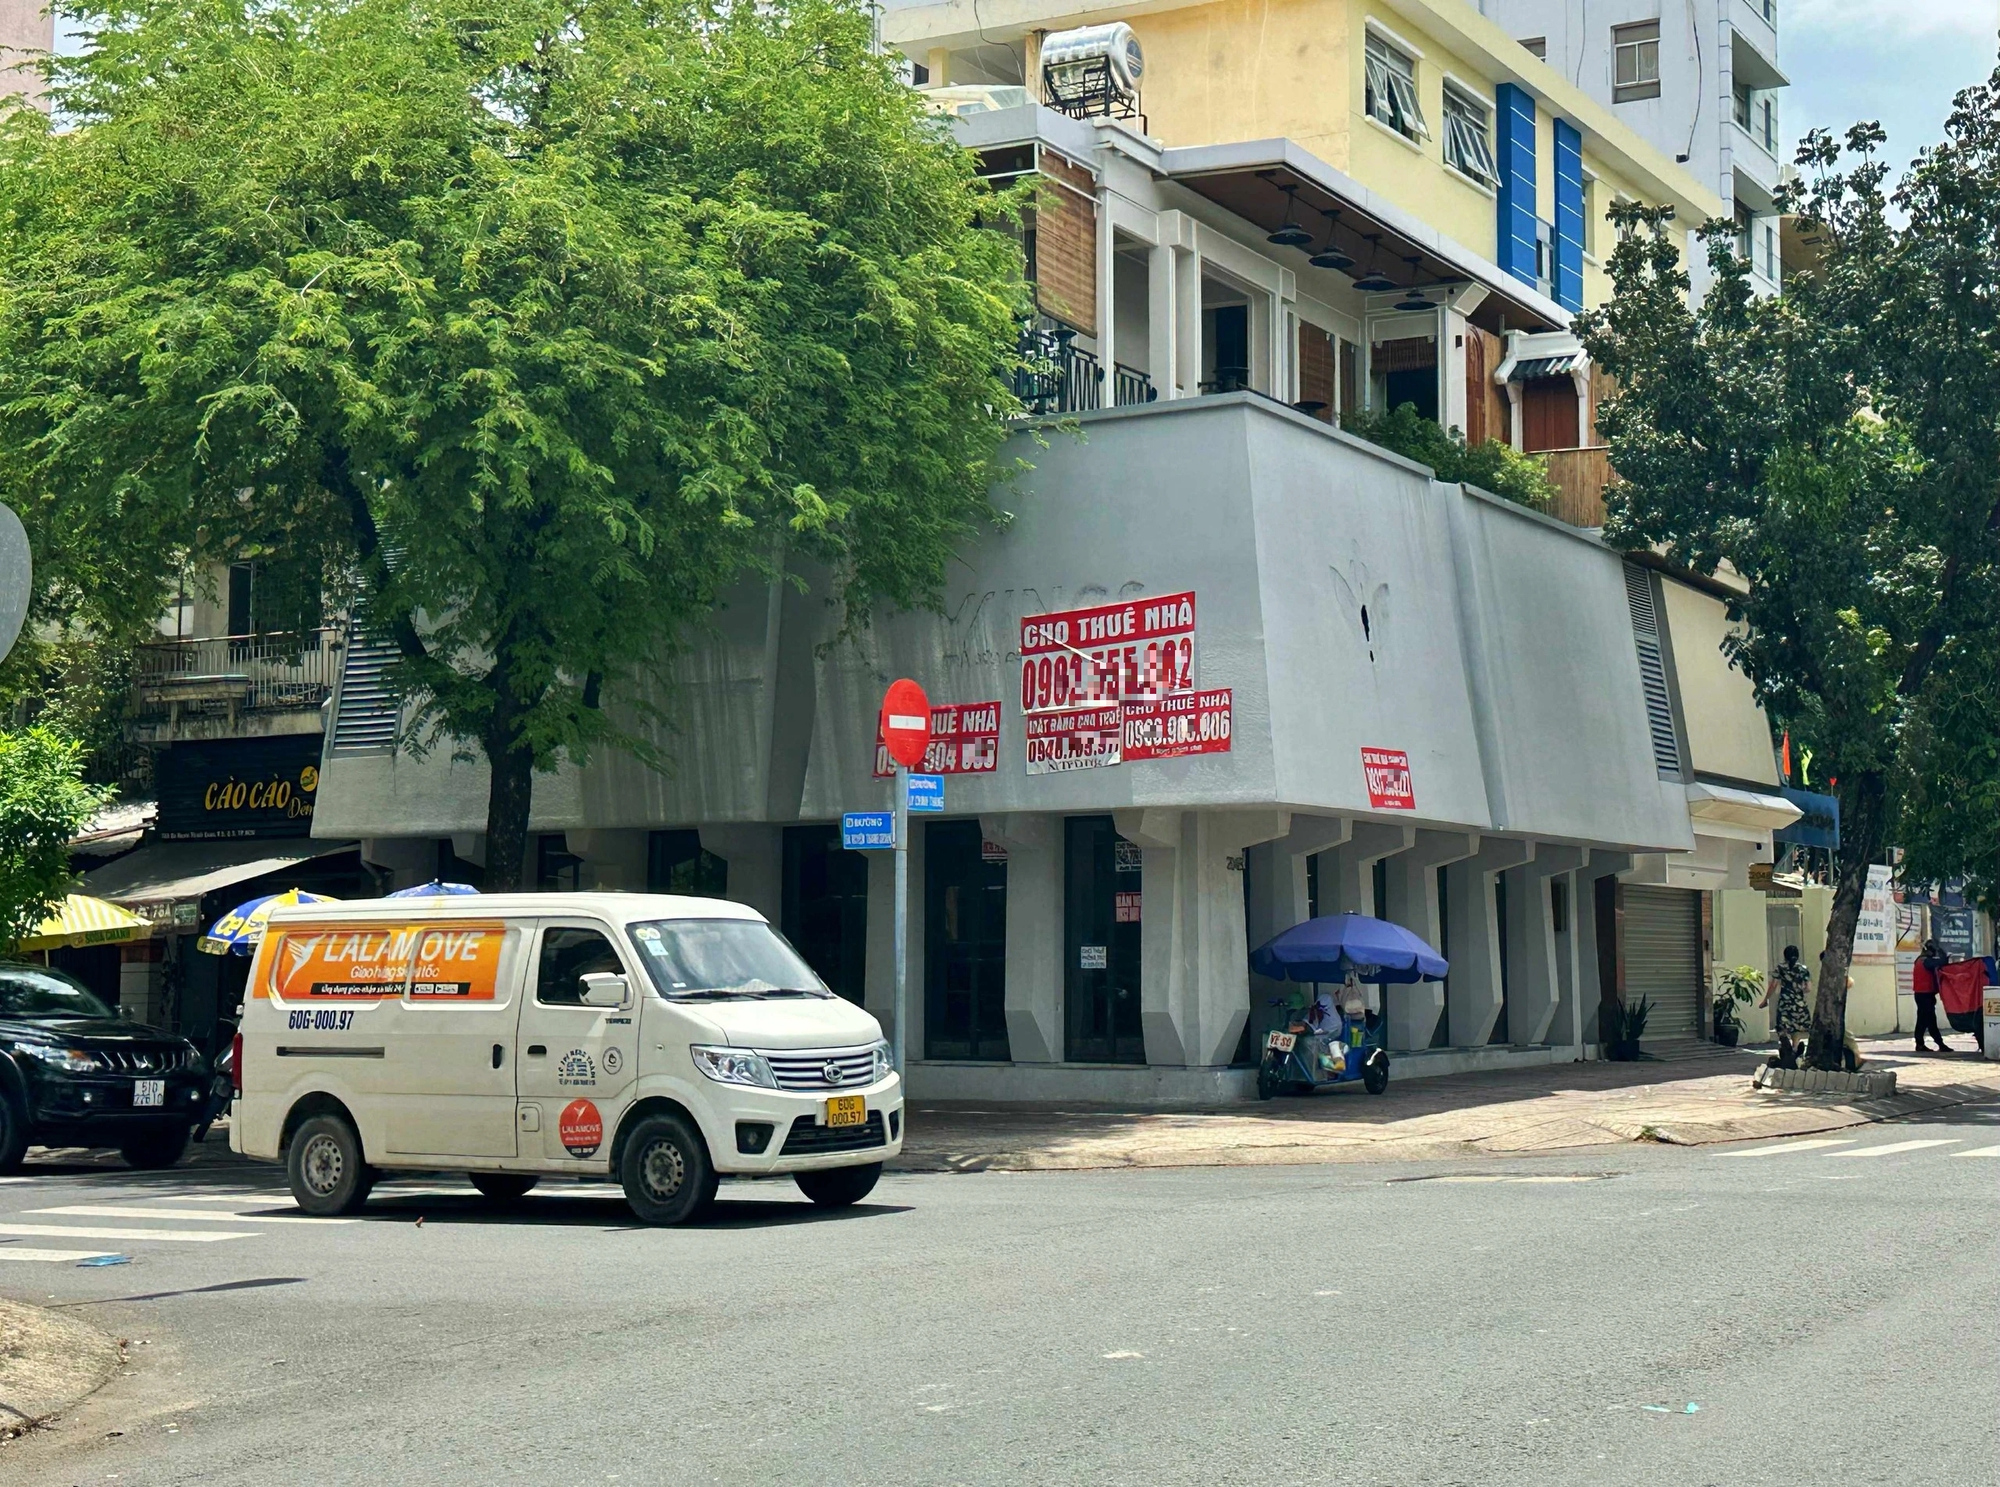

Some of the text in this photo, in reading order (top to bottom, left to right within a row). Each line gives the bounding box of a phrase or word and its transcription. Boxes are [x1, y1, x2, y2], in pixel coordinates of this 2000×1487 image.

[1024, 597, 1192, 648] CHO THUÊ NHÀ
[1160, 695, 1195, 712] THUÊ
[962, 704, 997, 732] NHÀ
[205, 772, 291, 811] CÀO CÀO
[323, 931, 486, 962] LALAMOVE
[289, 1010, 354, 1030] 60G-000.97
[838, 1098, 855, 1110] 60G
[832, 1111, 861, 1125] 000.97
[562, 1124, 600, 1134] LALAMOVE
